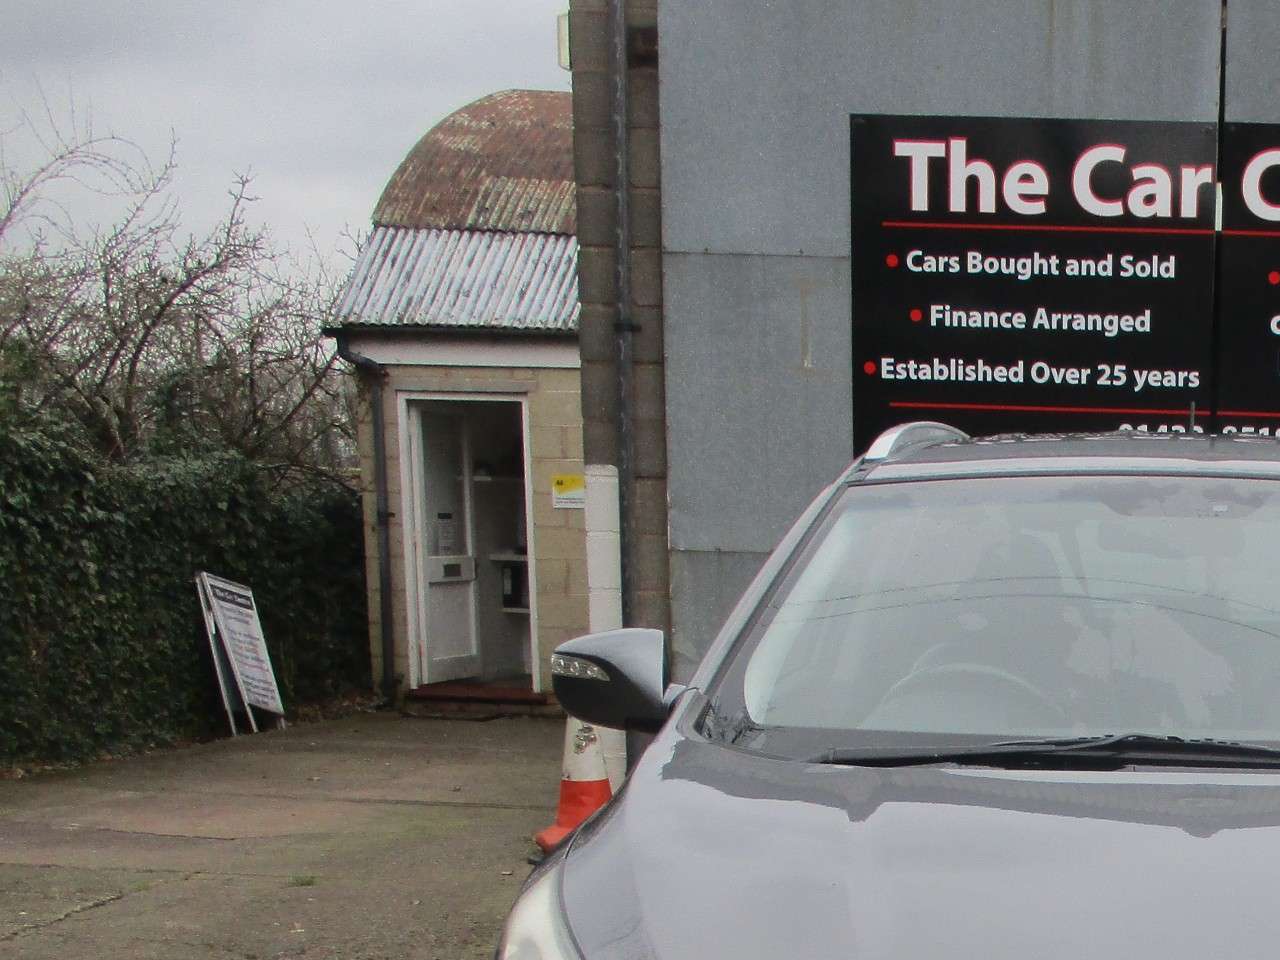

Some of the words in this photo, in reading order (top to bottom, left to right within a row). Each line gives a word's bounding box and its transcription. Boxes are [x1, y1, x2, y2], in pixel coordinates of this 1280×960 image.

[893, 136, 1049, 216] The
[1071, 143, 1213, 219] Car
[906, 250, 960, 274] Cars
[967, 251, 1059, 280] Bought
[1065, 254, 1113, 277] and
[1120, 255, 1176, 279] Sold
[930, 304, 1026, 330] Finance
[1033, 307, 1151, 338] Arranged
[880, 357, 1024, 384] Established
[1030, 361, 1092, 385] Over
[1097, 364, 1127, 387] 25
[1132, 368, 1200, 393] years
